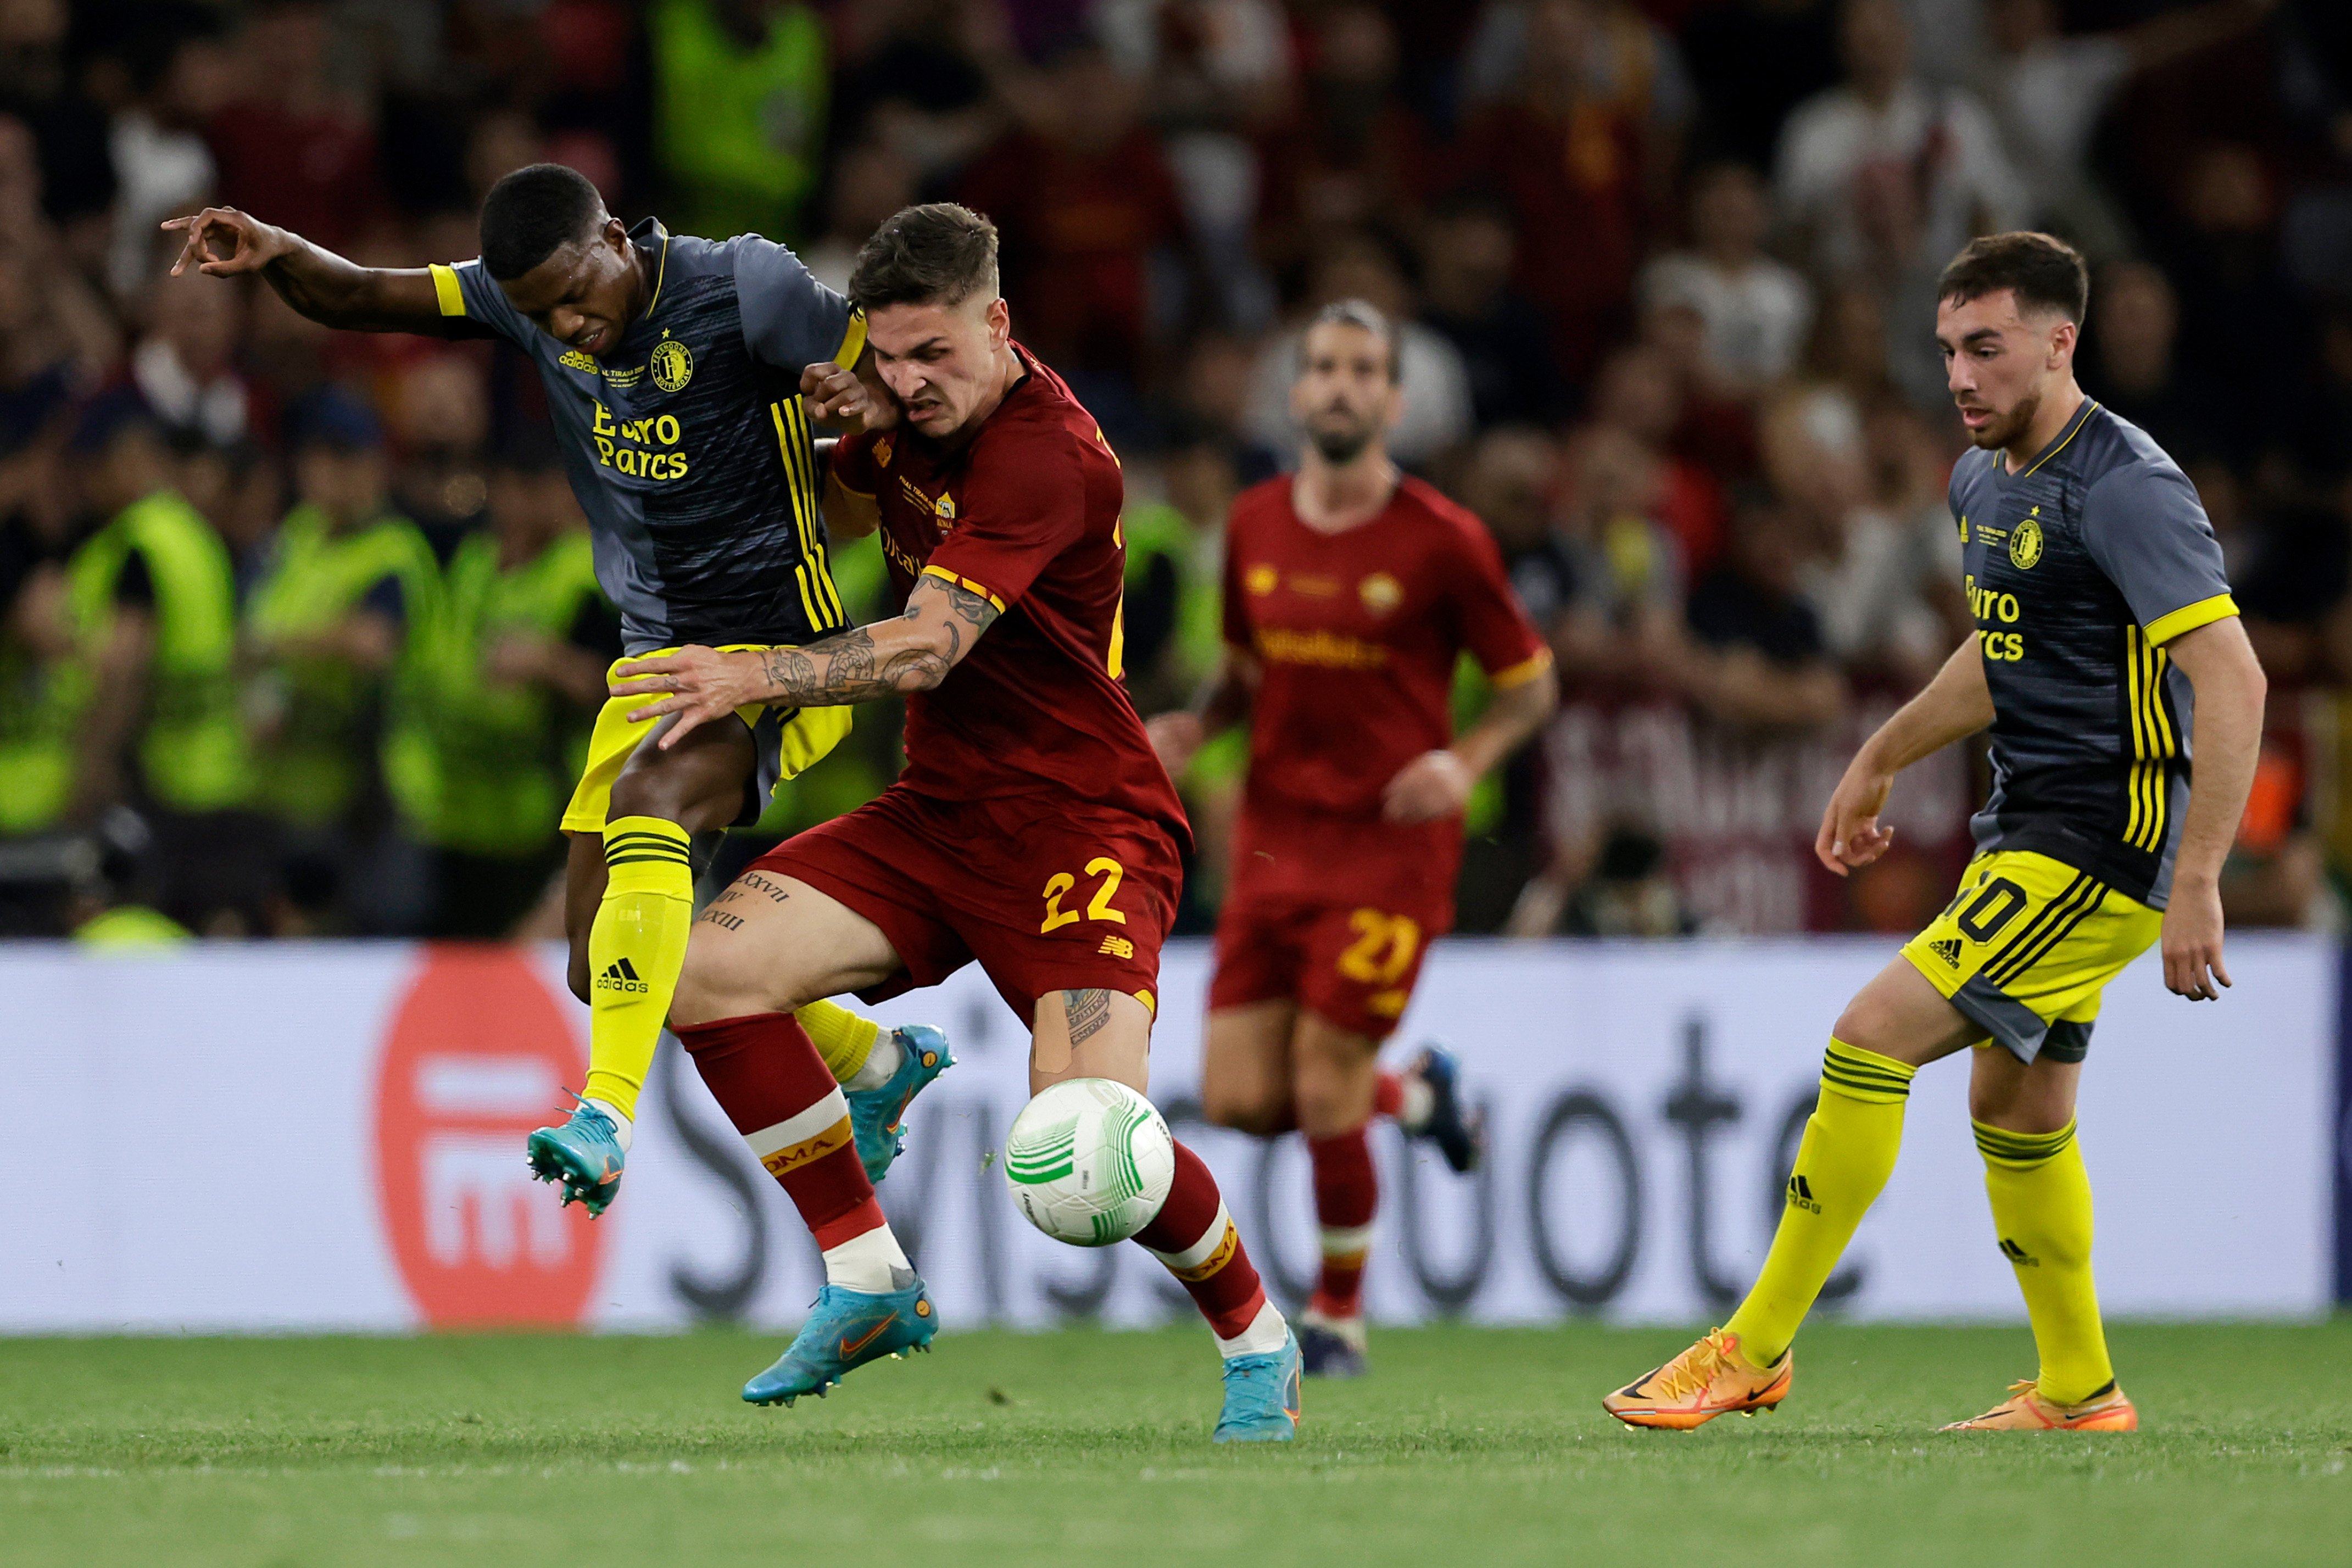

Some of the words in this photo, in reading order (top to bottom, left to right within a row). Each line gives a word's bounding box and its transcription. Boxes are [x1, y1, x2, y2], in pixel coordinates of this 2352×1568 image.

[559, 355, 599, 375] adidas
[592, 398, 681, 445] Euro
[594, 436, 688, 480] Parcs
[1041, 857, 1127, 934] 22
[1927, 941, 1960, 969] adidas
[597, 977, 649, 993] adidas
[763, 1140, 834, 1173] OMA
